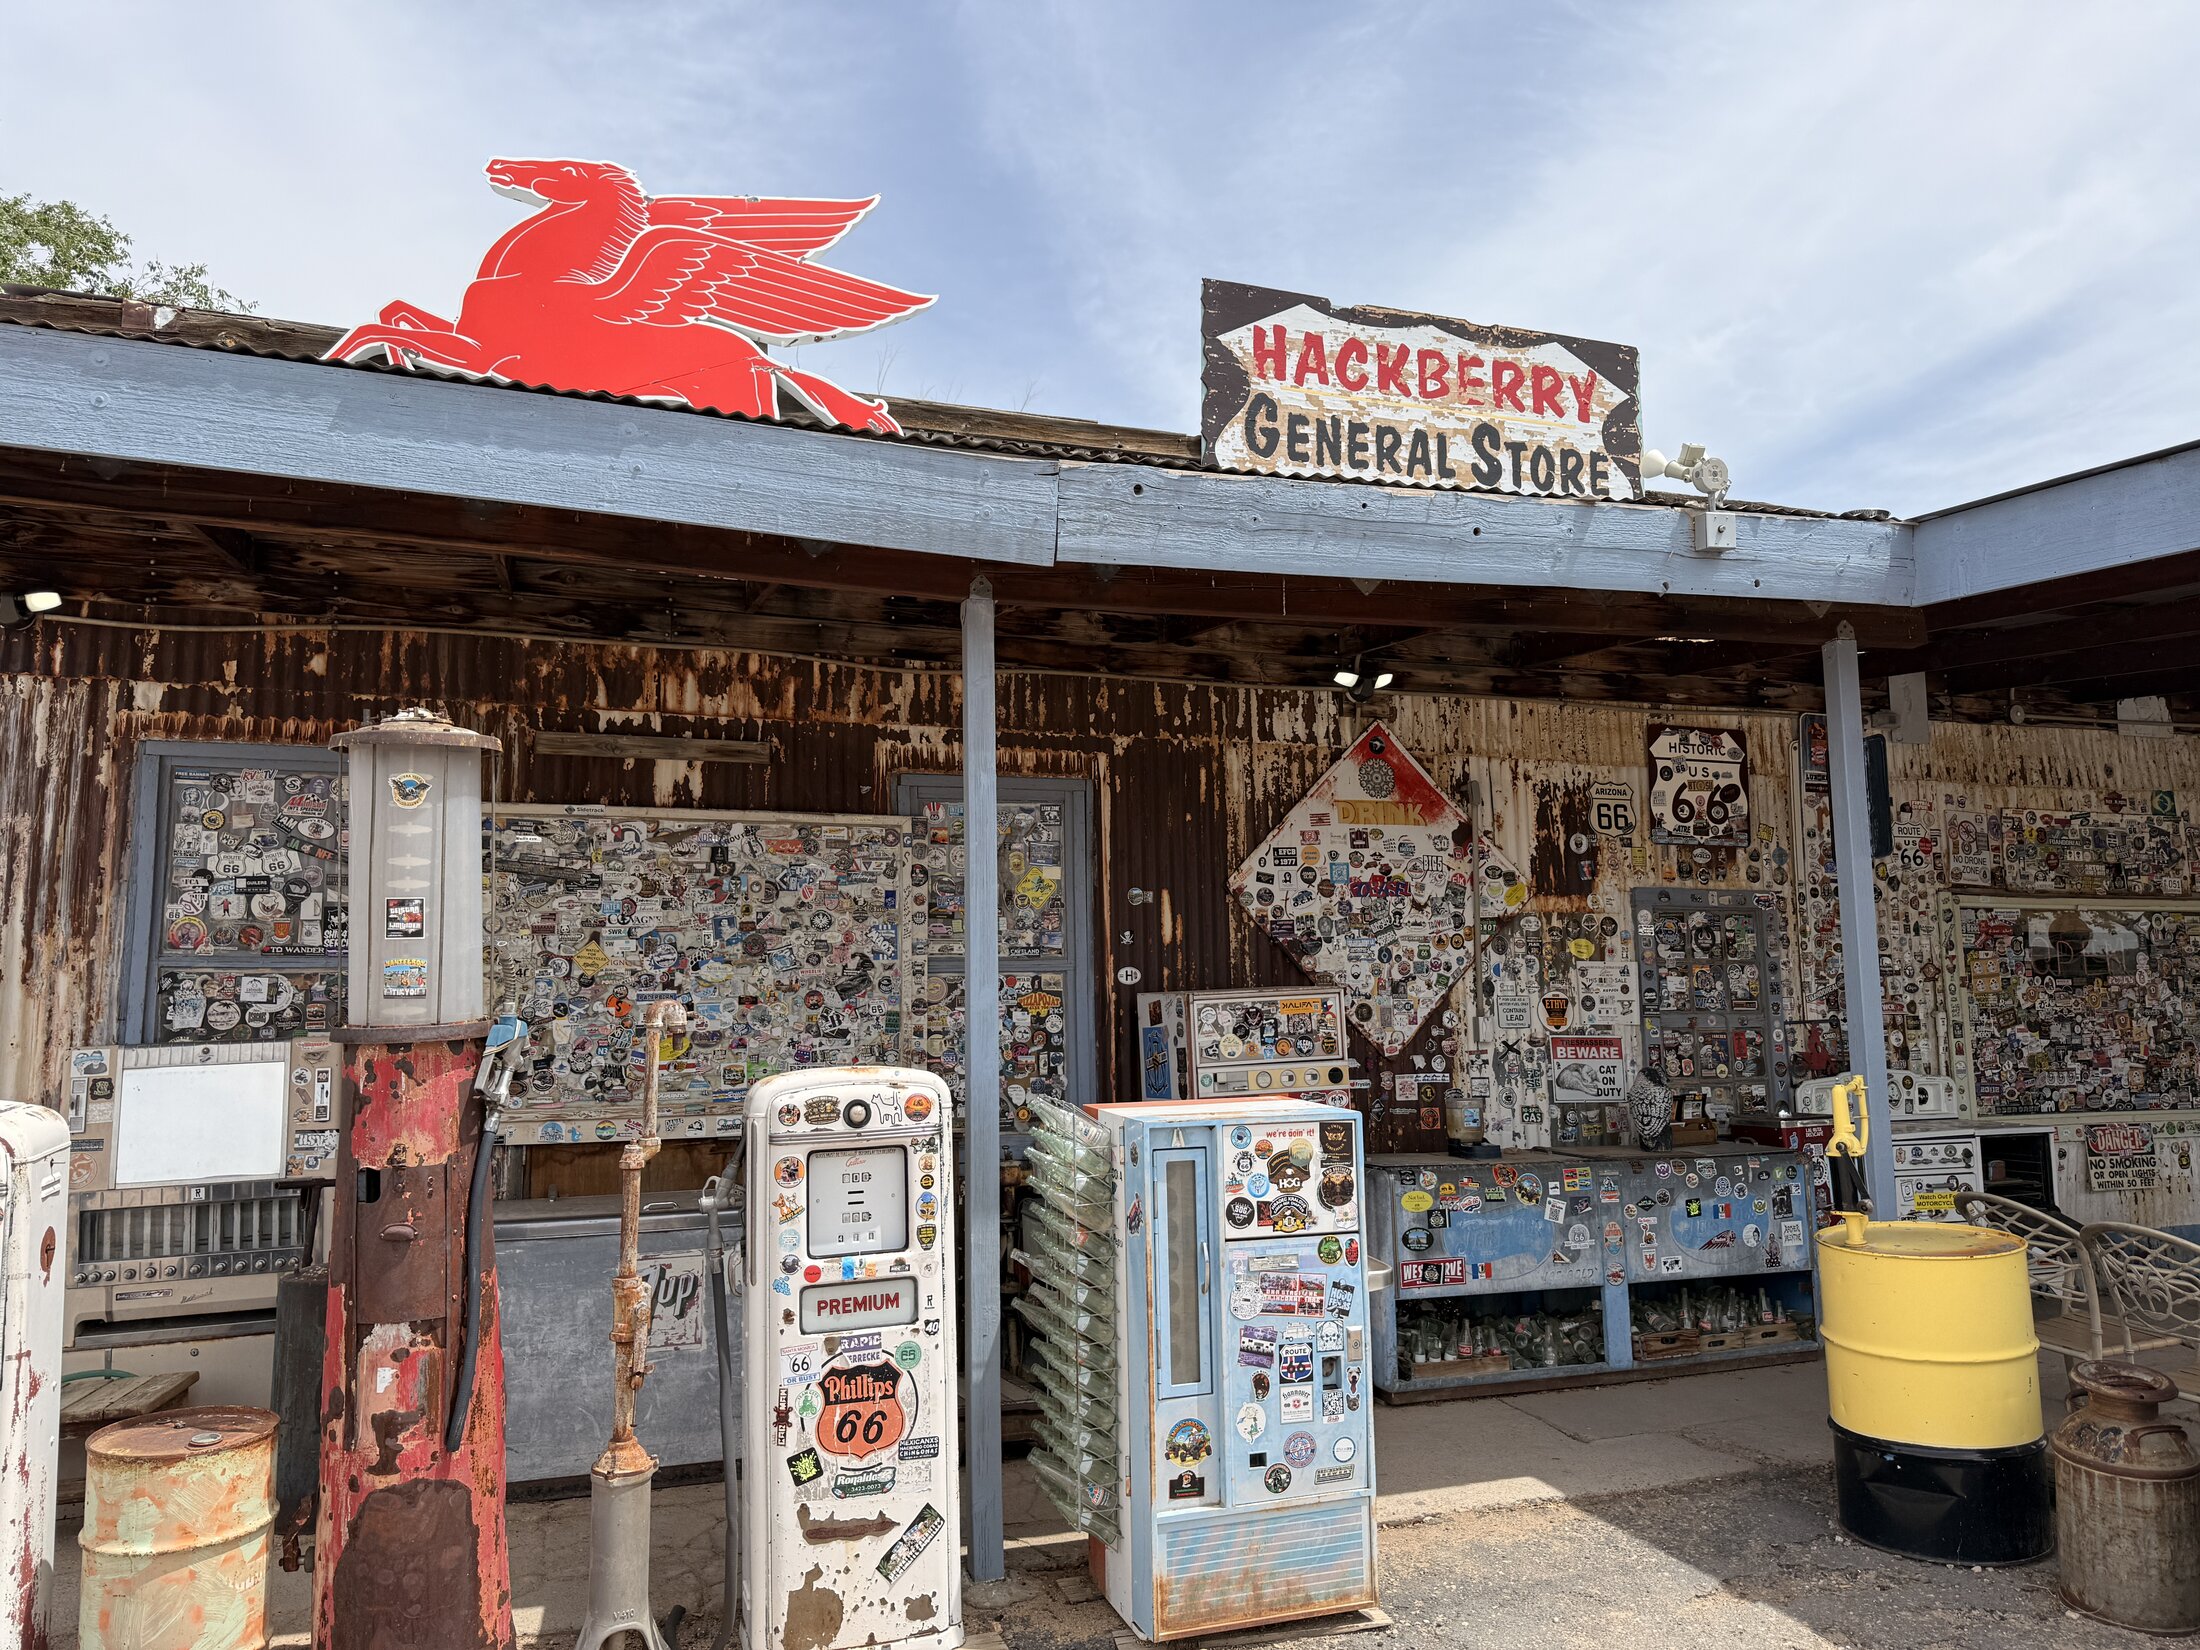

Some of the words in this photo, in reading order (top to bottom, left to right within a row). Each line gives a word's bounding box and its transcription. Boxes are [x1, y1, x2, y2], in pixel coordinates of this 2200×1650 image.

[1252, 324, 1597, 423] HACKBERRY
[1244, 392, 1456, 479] GENERAL
[1470, 422, 1610, 497] STORE
[1669, 742, 1726, 757] HISTORIC
[1595, 787, 1627, 797] ARIZONA
[1672, 782, 1729, 824] 66
[1338, 800, 1427, 827] DRINK
[1597, 803, 1629, 829] 66
[1898, 826, 1921, 836] ROUTE
[1904, 839, 1917, 847] US
[1901, 849, 1923, 866] 66
[1953, 855, 1963, 864] NO
[1965, 855, 1987, 866] DRONE
[223, 864, 240, 873] 66
[269, 860, 286, 871] 66
[1962, 866, 1980, 875] ZONE
[602, 903, 620, 911] INTER
[270, 946, 283, 954] TO
[285, 946, 325, 954] WANDER
[1545, 998, 1567, 1010] ETHYL
[871, 1006, 884, 1014] 66
[1505, 1014, 1525, 1022] LEAD
[1560, 1039, 1614, 1047] TRESPASSERS
[1556, 1047, 1620, 1059] BEWARE
[1599, 1066, 1617, 1075] CAT
[1601, 1076, 1616, 1086] ON
[1597, 1087, 1622, 1097] DUTY
[1522, 1111, 1542, 1123] GAS
[1266, 1128, 1287, 1138] we're
[1306, 1128, 1315, 1137] it!
[2096, 1128, 2142, 1149] DANGER
[1240, 1162, 1249, 1170] 66
[2089, 1158, 2106, 1170] NO
[2109, 1157, 2157, 1169] SMOKING
[2093, 1171, 2105, 1179] OR
[2109, 1171, 2128, 1179] OPEN
[2132, 1170, 2156, 1178] LIGHTS
[1279, 1177, 1301, 1189] HOG
[2097, 1180, 2125, 1189] WITHIN
[2128, 1179, 2137, 1187] 50
[2140, 1179, 2155, 1187] FEET
[1574, 1233, 1585, 1241] 66
[817, 1292, 900, 1316] PREMIUM
[926, 1294, 933, 1306] R
[925, 1321, 939, 1332] 40
[782, 1346, 798, 1355] SANTA
[798, 1344, 816, 1352] MONICA
[791, 1358, 810, 1373] 66
[799, 1373, 818, 1382] BUST
[824, 1373, 894, 1404] Phillips
[836, 1410, 887, 1445] 66
[899, 1436, 939, 1447] MEXICANXS
[836, 1473, 879, 1486] Ronaldo
